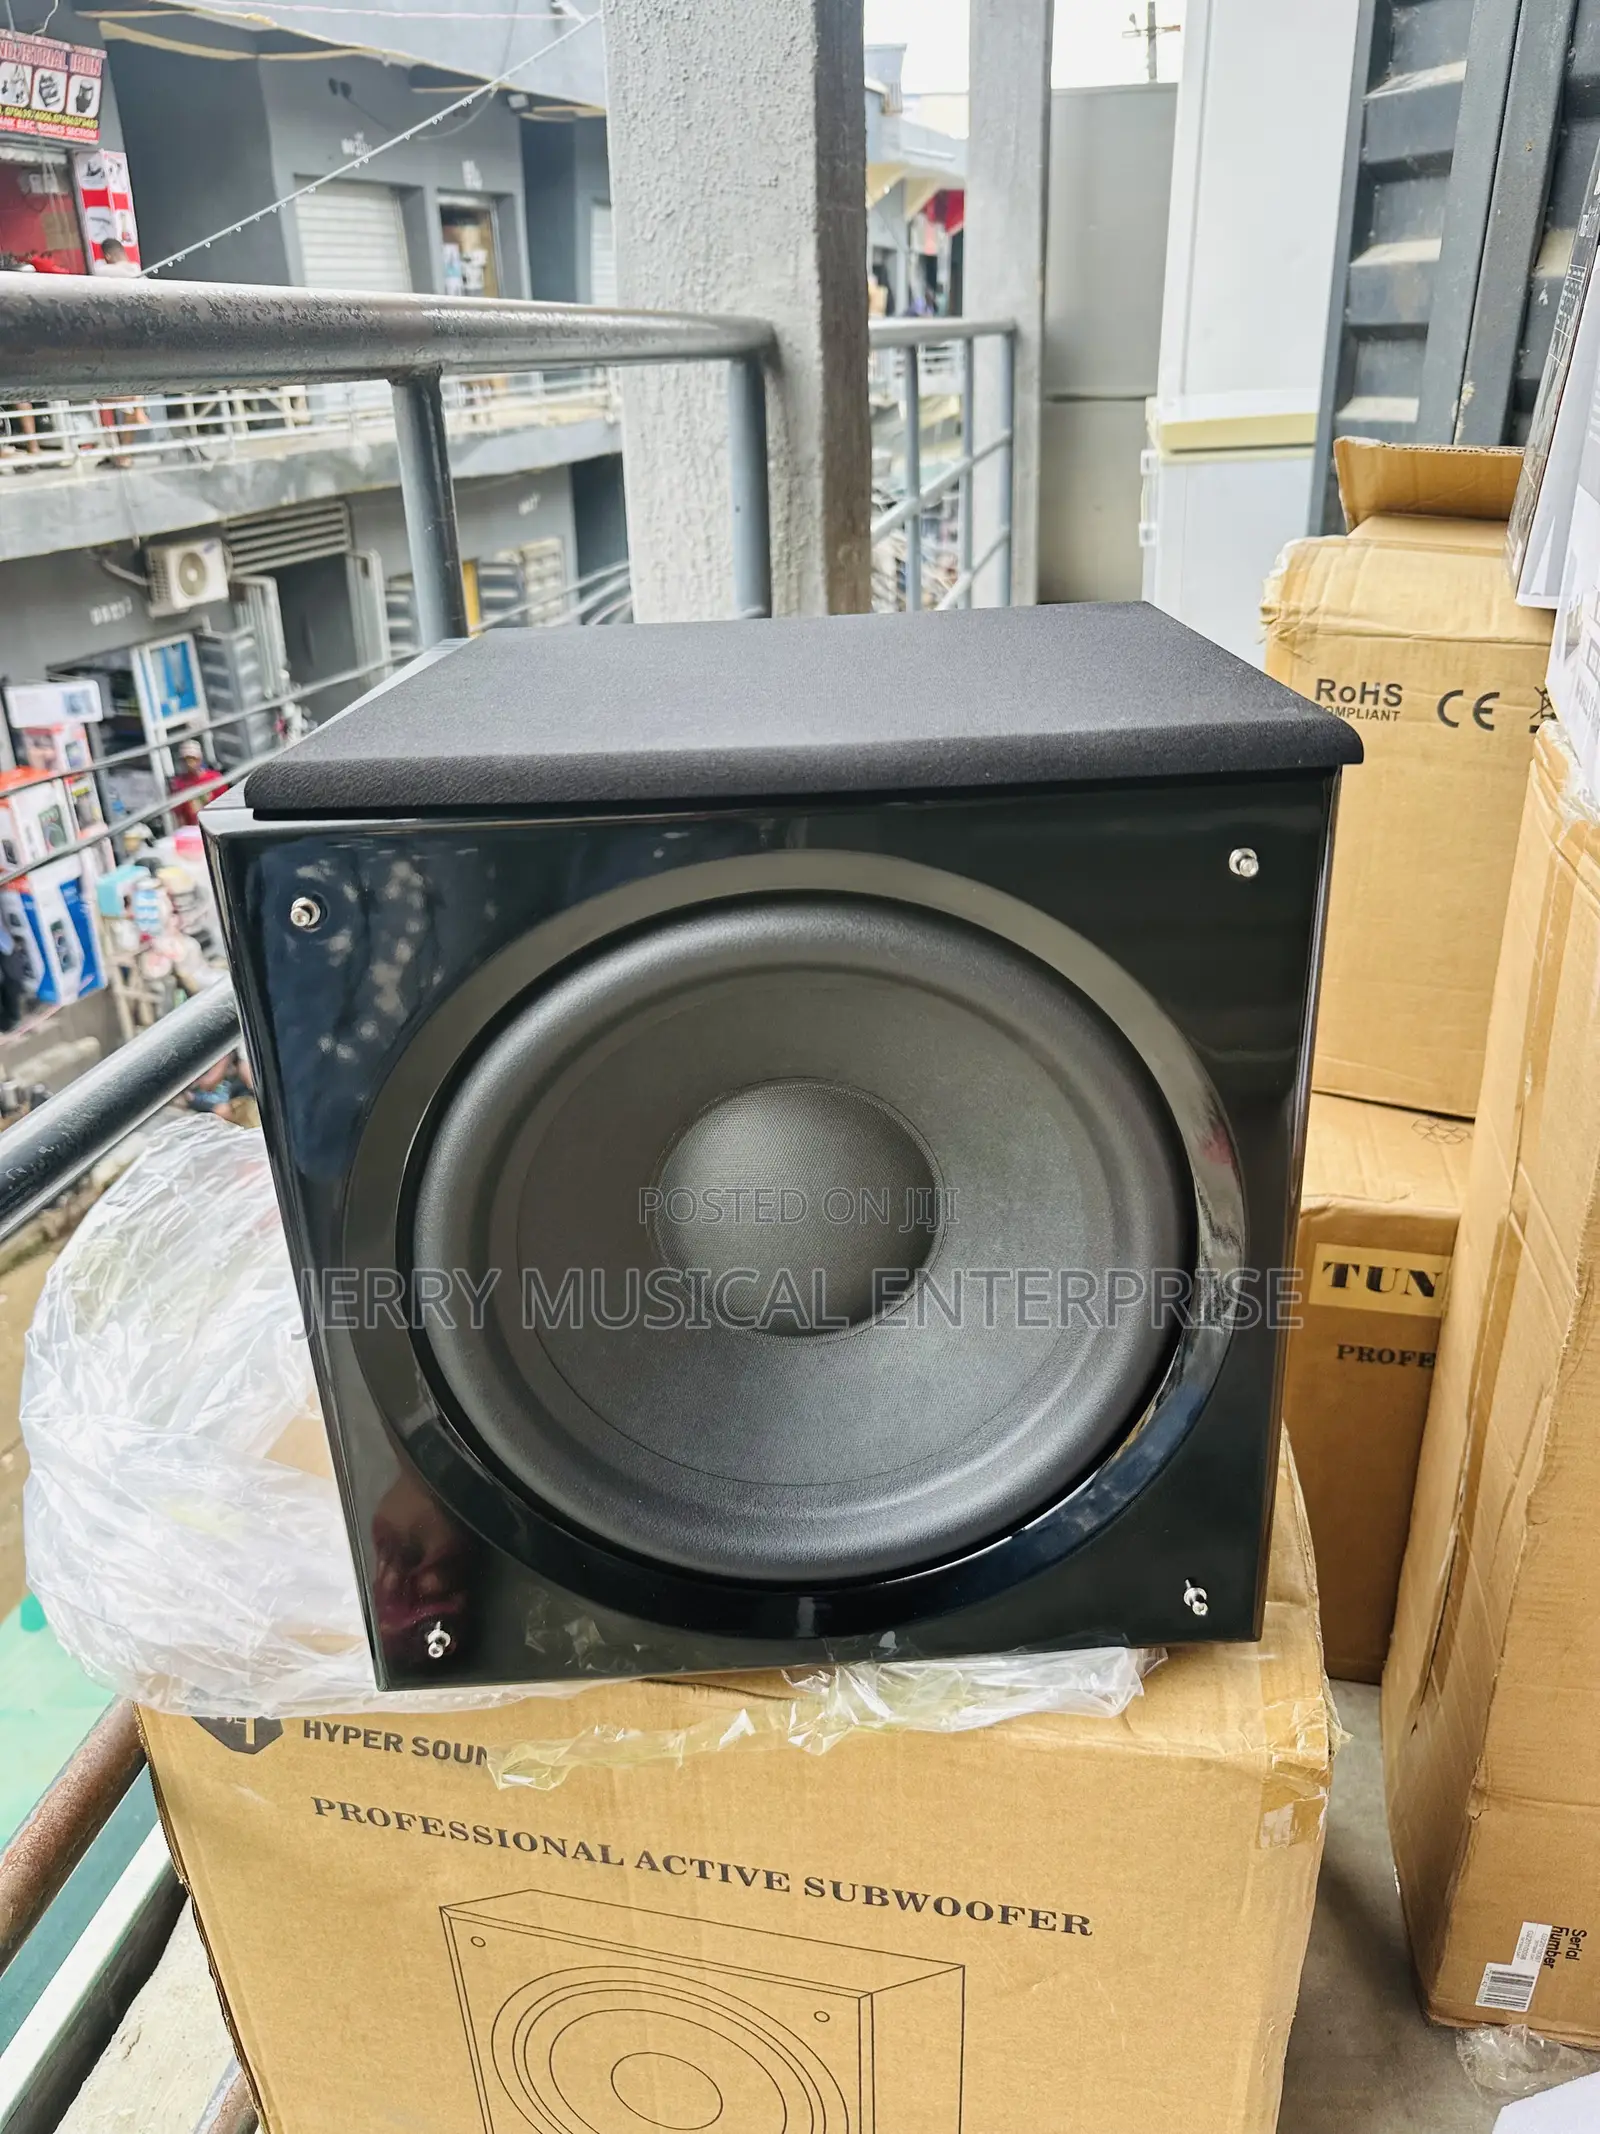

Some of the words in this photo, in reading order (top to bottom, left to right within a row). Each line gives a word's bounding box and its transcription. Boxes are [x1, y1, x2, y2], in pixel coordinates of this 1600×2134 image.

[1315, 678, 1404, 708] RoHS
[303, 1719, 404, 1753] HYPER
[310, 1796, 625, 1866] PROFESSIONAL
[633, 1849, 791, 1893] ACTIVE
[803, 1875, 1094, 1936] SUBWOOFER
[1564, 1928, 1588, 1961] Serial
